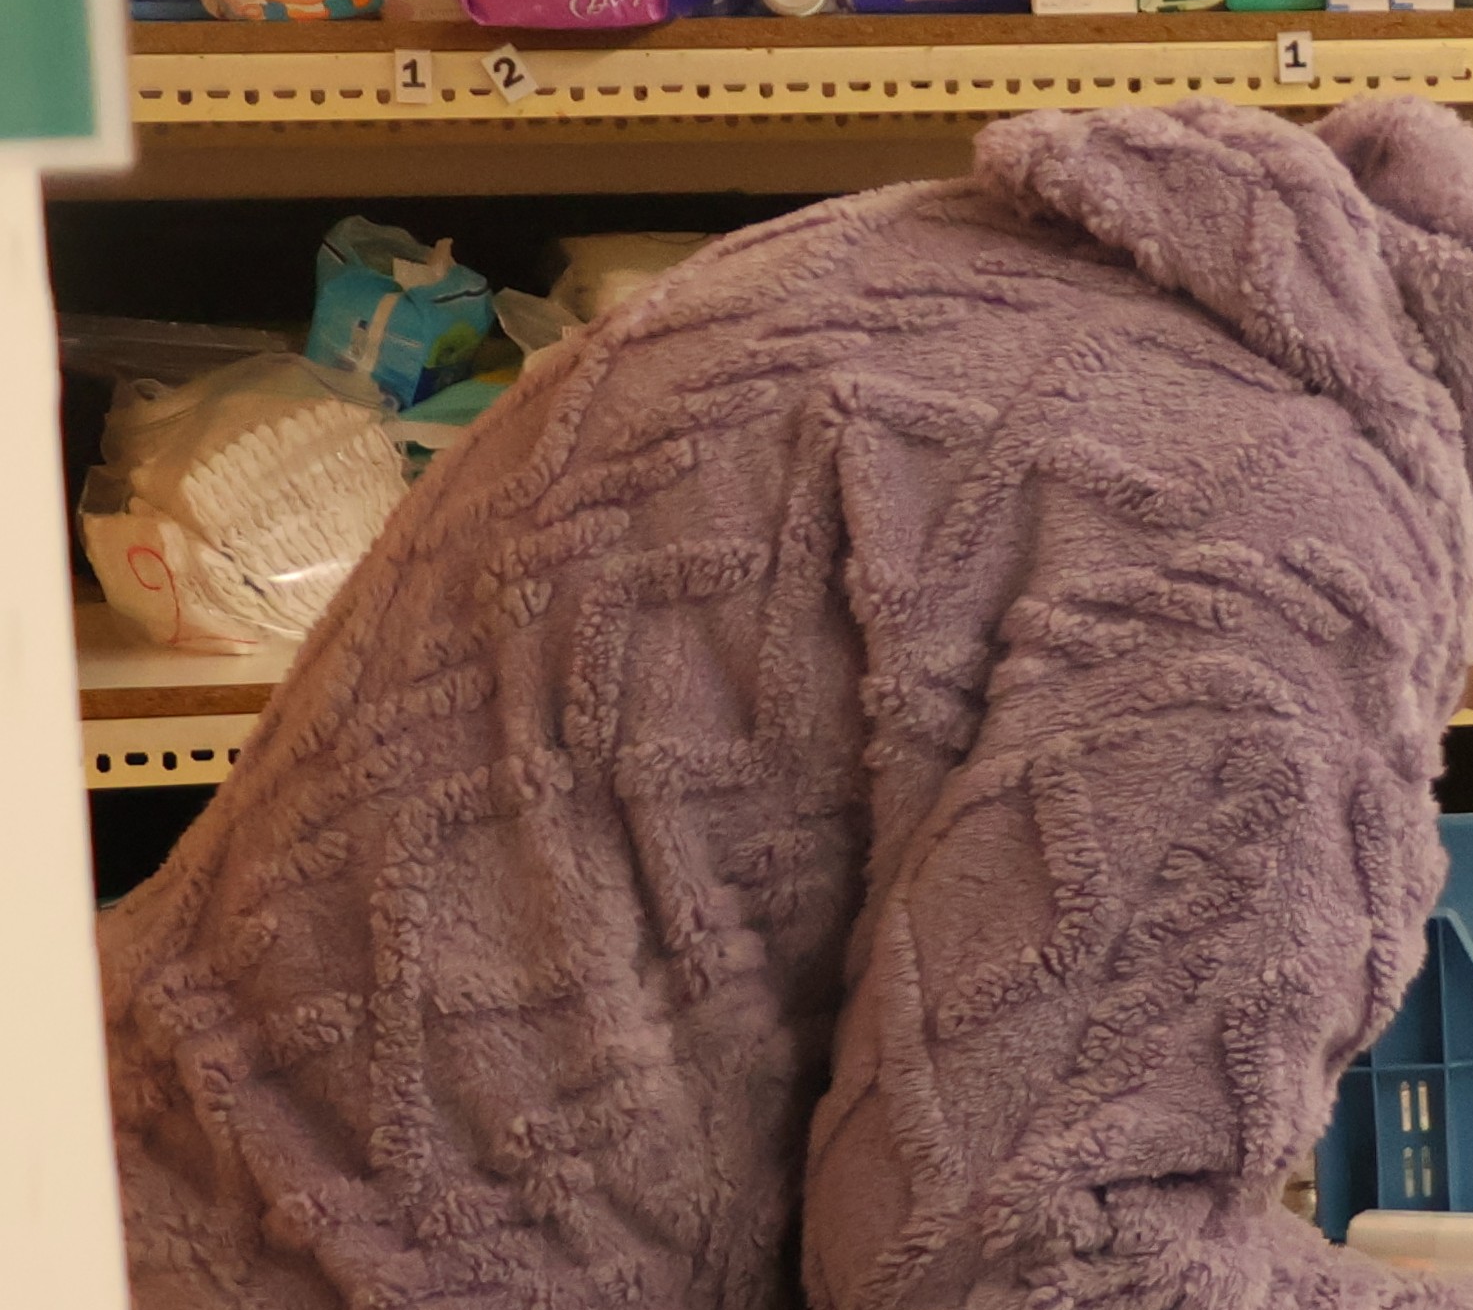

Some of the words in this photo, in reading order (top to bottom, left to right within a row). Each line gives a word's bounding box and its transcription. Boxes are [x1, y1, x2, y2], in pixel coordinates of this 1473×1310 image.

[1285, 41, 1307, 69] 1
[403, 58, 425, 87] 1
[493, 57, 521, 87] 2
